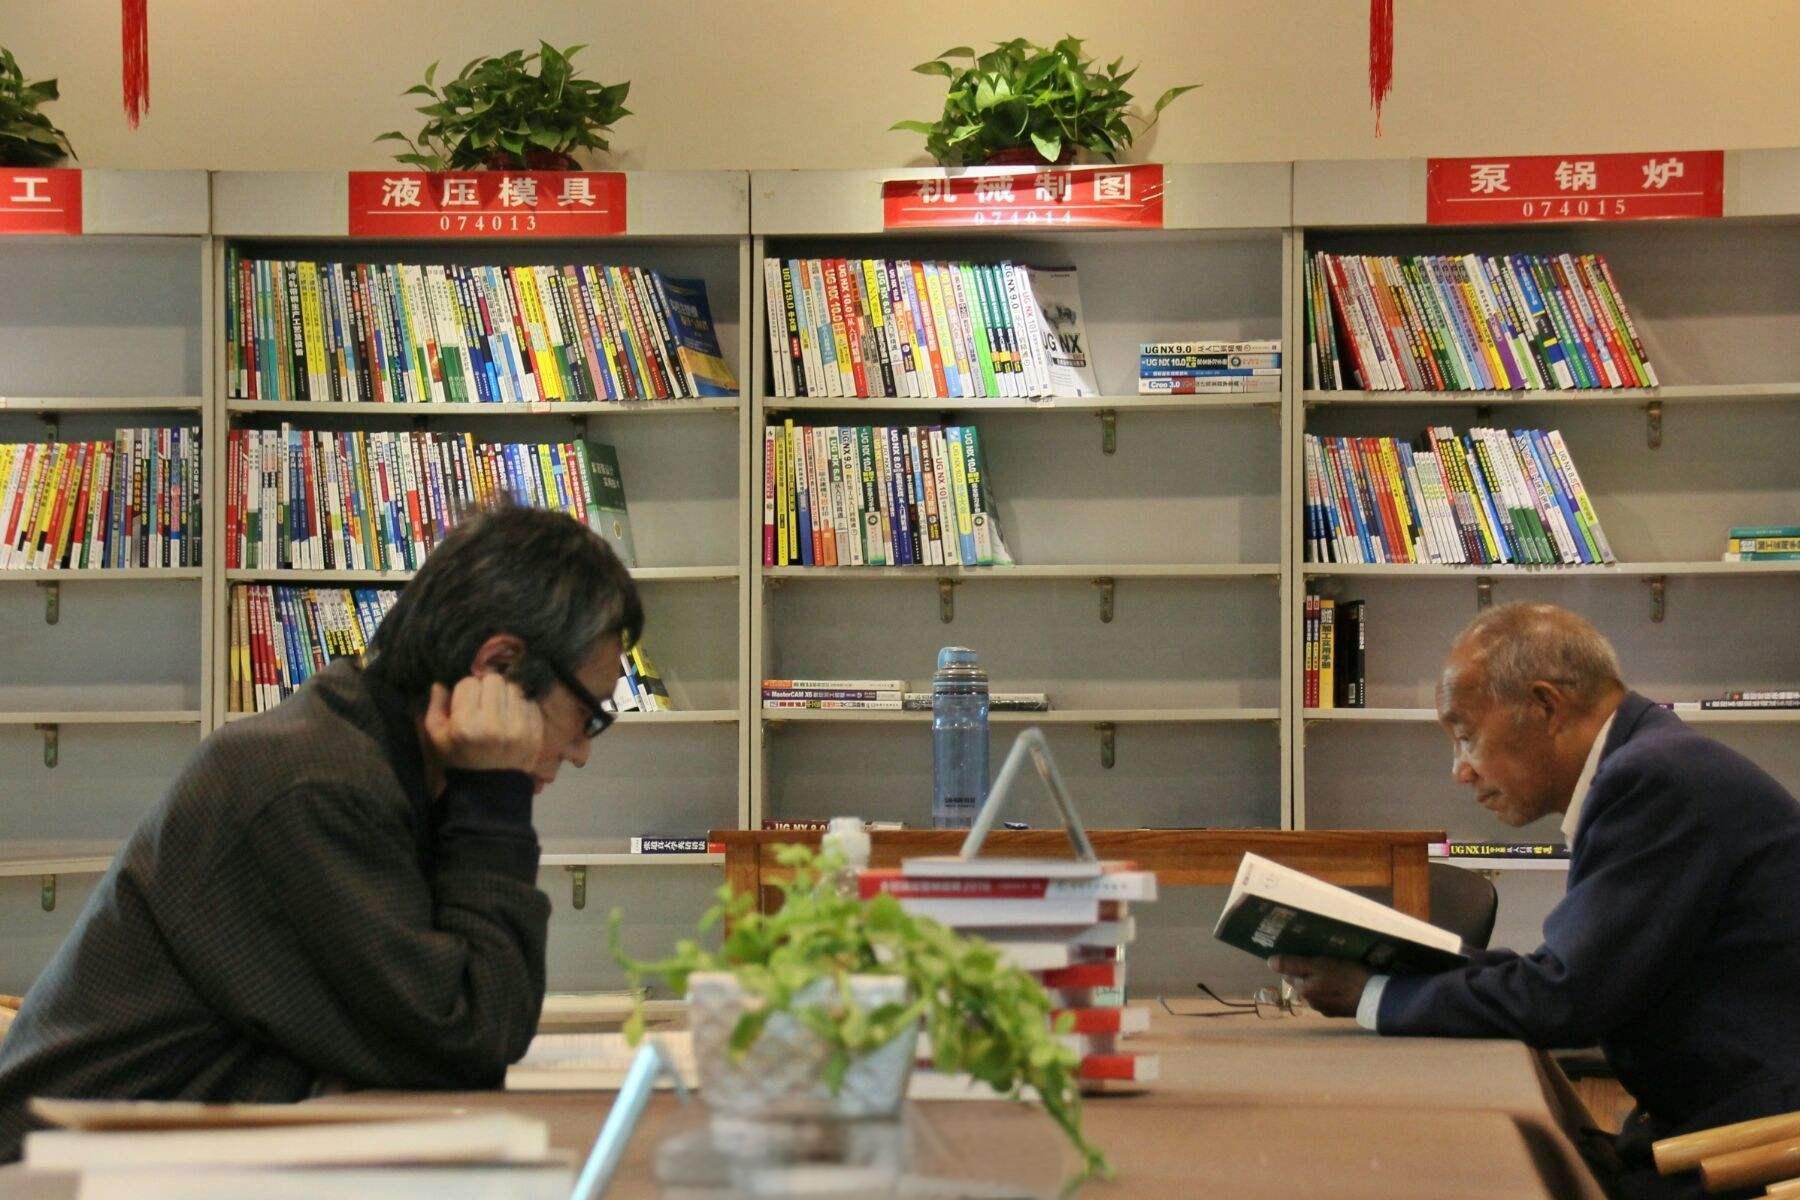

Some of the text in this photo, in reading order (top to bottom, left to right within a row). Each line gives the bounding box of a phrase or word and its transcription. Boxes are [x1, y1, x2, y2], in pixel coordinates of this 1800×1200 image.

[1470, 157, 1684, 193] 泵锅炉
[10, 176, 52, 203] 工
[381, 177, 596, 207] 液压模具
[916, 172, 1131, 203] 机械制图
[1522, 199, 1626, 217] 074015
[440, 216, 536, 231] 074013
[974, 210, 1072, 225] 074014
[838, 264, 847, 278] UG
[1004, 263, 1013, 278] UG
[841, 278, 850, 291] NX
[878, 272, 886, 285] UG
[880, 286, 888, 300] NX
[1007, 279, 1016, 293] NX
[825, 269, 843, 322] UG NX 10.0
[1010, 294, 1019, 310] 9.0
[844, 293, 852, 313] 10.0
[1059, 334, 1082, 354] NX
[1171, 358, 1186, 366] 10.0
[842, 430, 850, 442] UG
[861, 432, 869, 444] UG
[890, 429, 898, 442] UG
[964, 433, 973, 445] UG
[831, 439, 838, 452] UG
[843, 443, 851, 455] NX
[892, 442, 900, 454] NX
[832, 454, 839, 466] NX
[863, 457, 872, 471] 10.0
[968, 458, 977, 472] 10.0
[1558, 450, 1568, 462] UG
[1563, 461, 1573, 473] NX
[936, 458, 947, 497] UG NX 10
[1451, 845, 1464, 854] UG
[1466, 845, 1480, 854] NX
